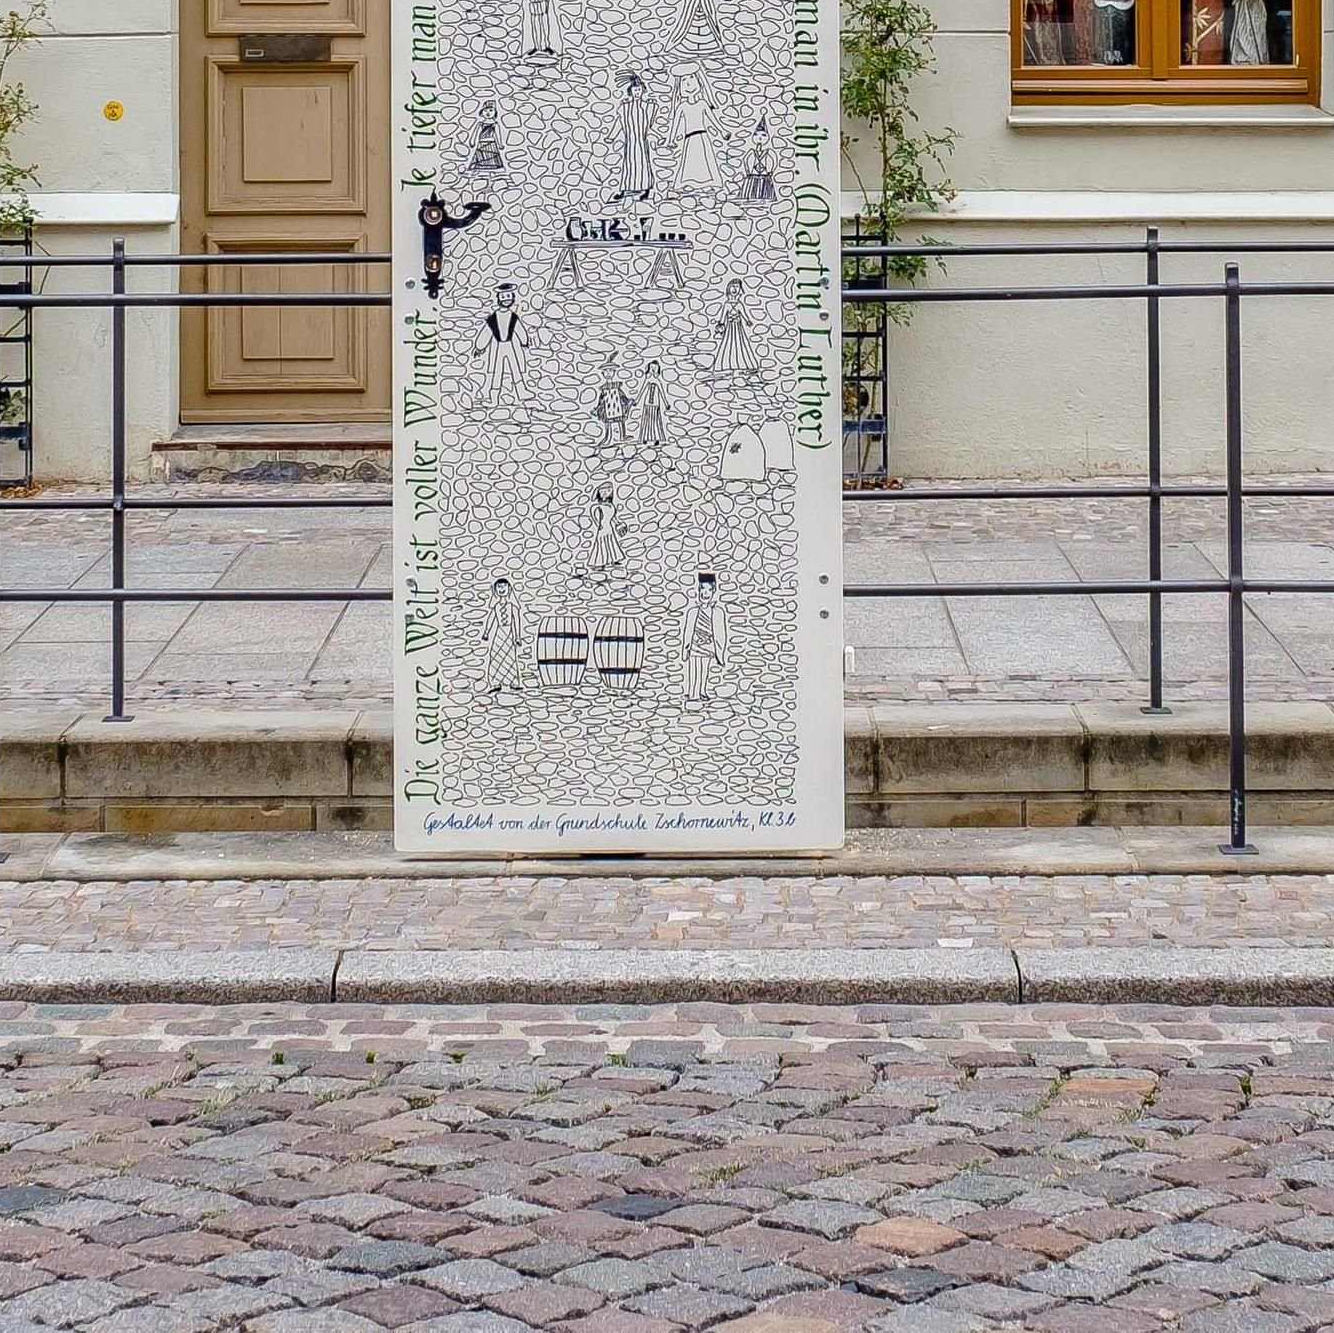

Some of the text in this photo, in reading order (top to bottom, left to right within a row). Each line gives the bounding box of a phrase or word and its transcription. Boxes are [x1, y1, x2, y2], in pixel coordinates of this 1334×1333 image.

[411, 4, 437, 63] man
[400, 70, 442, 153] tiefer
[794, 84, 829, 111] in
[794, 123, 829, 175] ihr.
[400, 167, 437, 197] Je
[794, 183, 833, 309] (Martin
[794, 326, 833, 450] Luther)
[404, 307, 447, 805] Die ganze Welt ist voller Wunder.
[424, 812, 493, 835] Gestaltet
[499, 819, 525, 830] von
[527, 814, 550, 830] der
[556, 813, 648, 837] Grundschule
